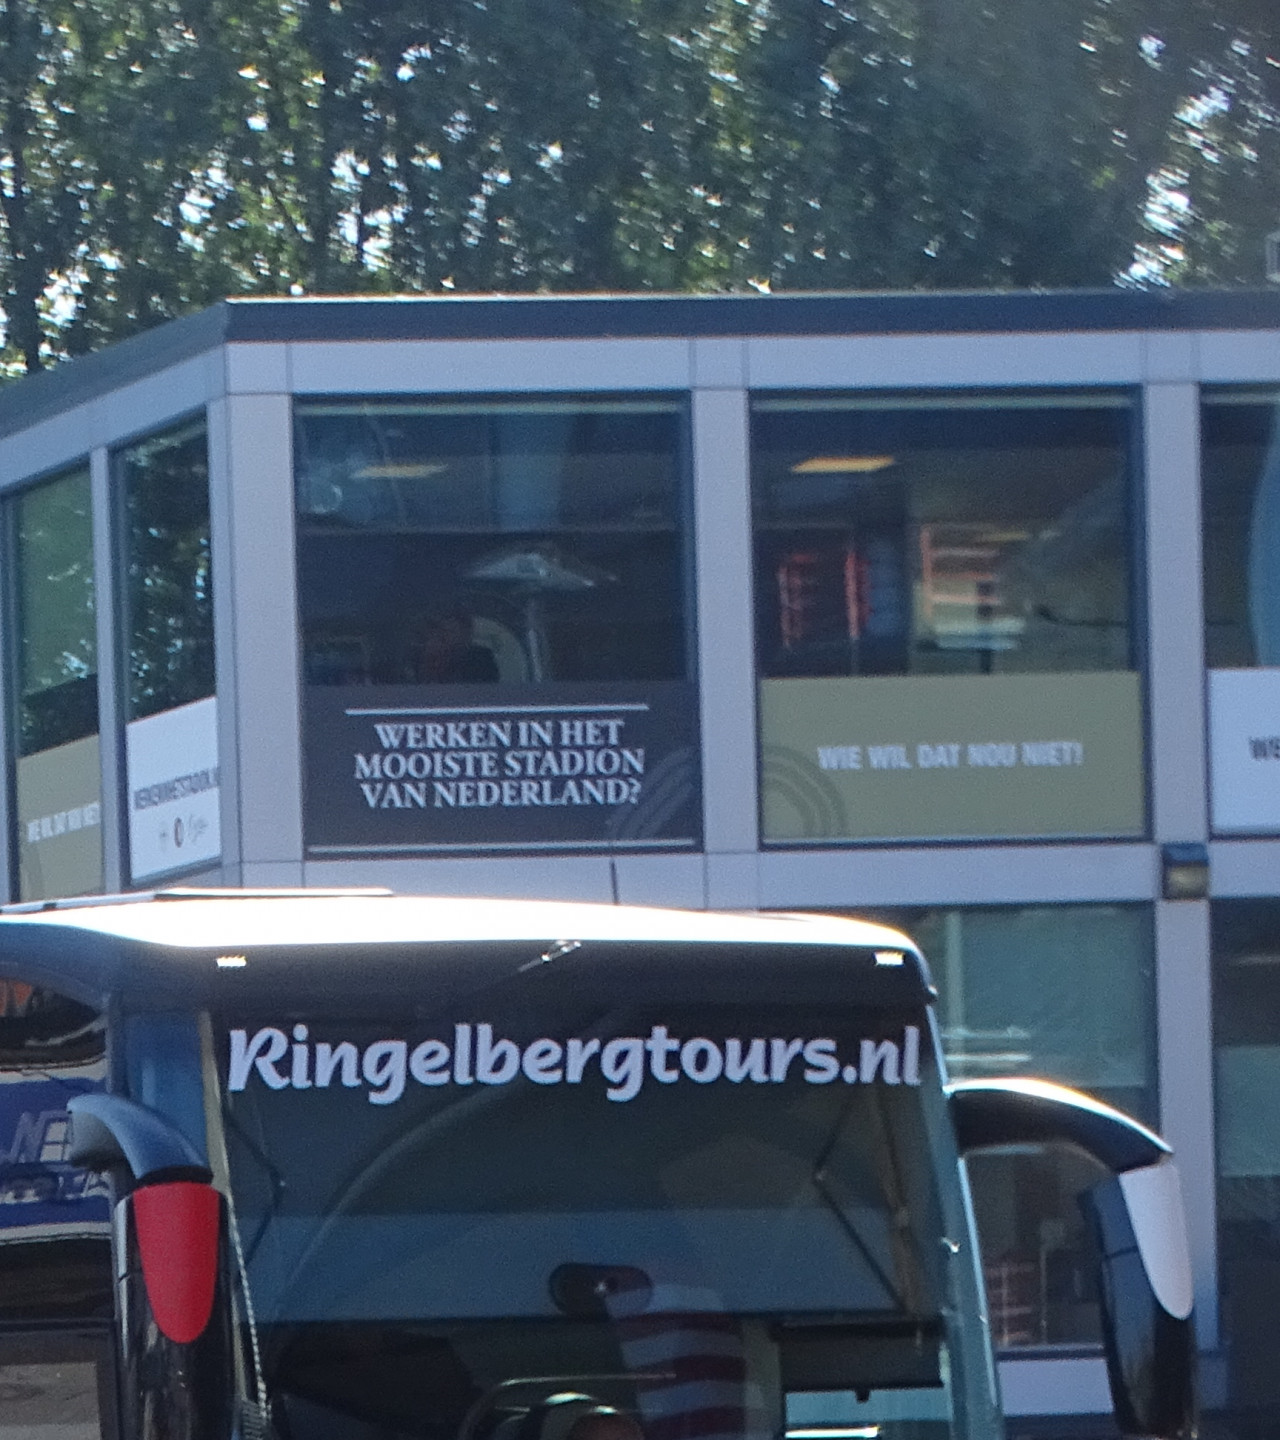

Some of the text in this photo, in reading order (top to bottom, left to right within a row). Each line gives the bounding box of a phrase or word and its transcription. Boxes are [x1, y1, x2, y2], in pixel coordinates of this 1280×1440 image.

[373, 718, 626, 749] WERKEN IN HET
[353, 748, 646, 780] MOOISTE STADION
[867, 744, 913, 770] WIL
[916, 743, 961, 769] DAT
[966, 742, 1017, 768] NOU
[360, 778, 642, 808] VAN NEDERLAND?
[228, 1024, 923, 1104] Ringelbergtours.nl
